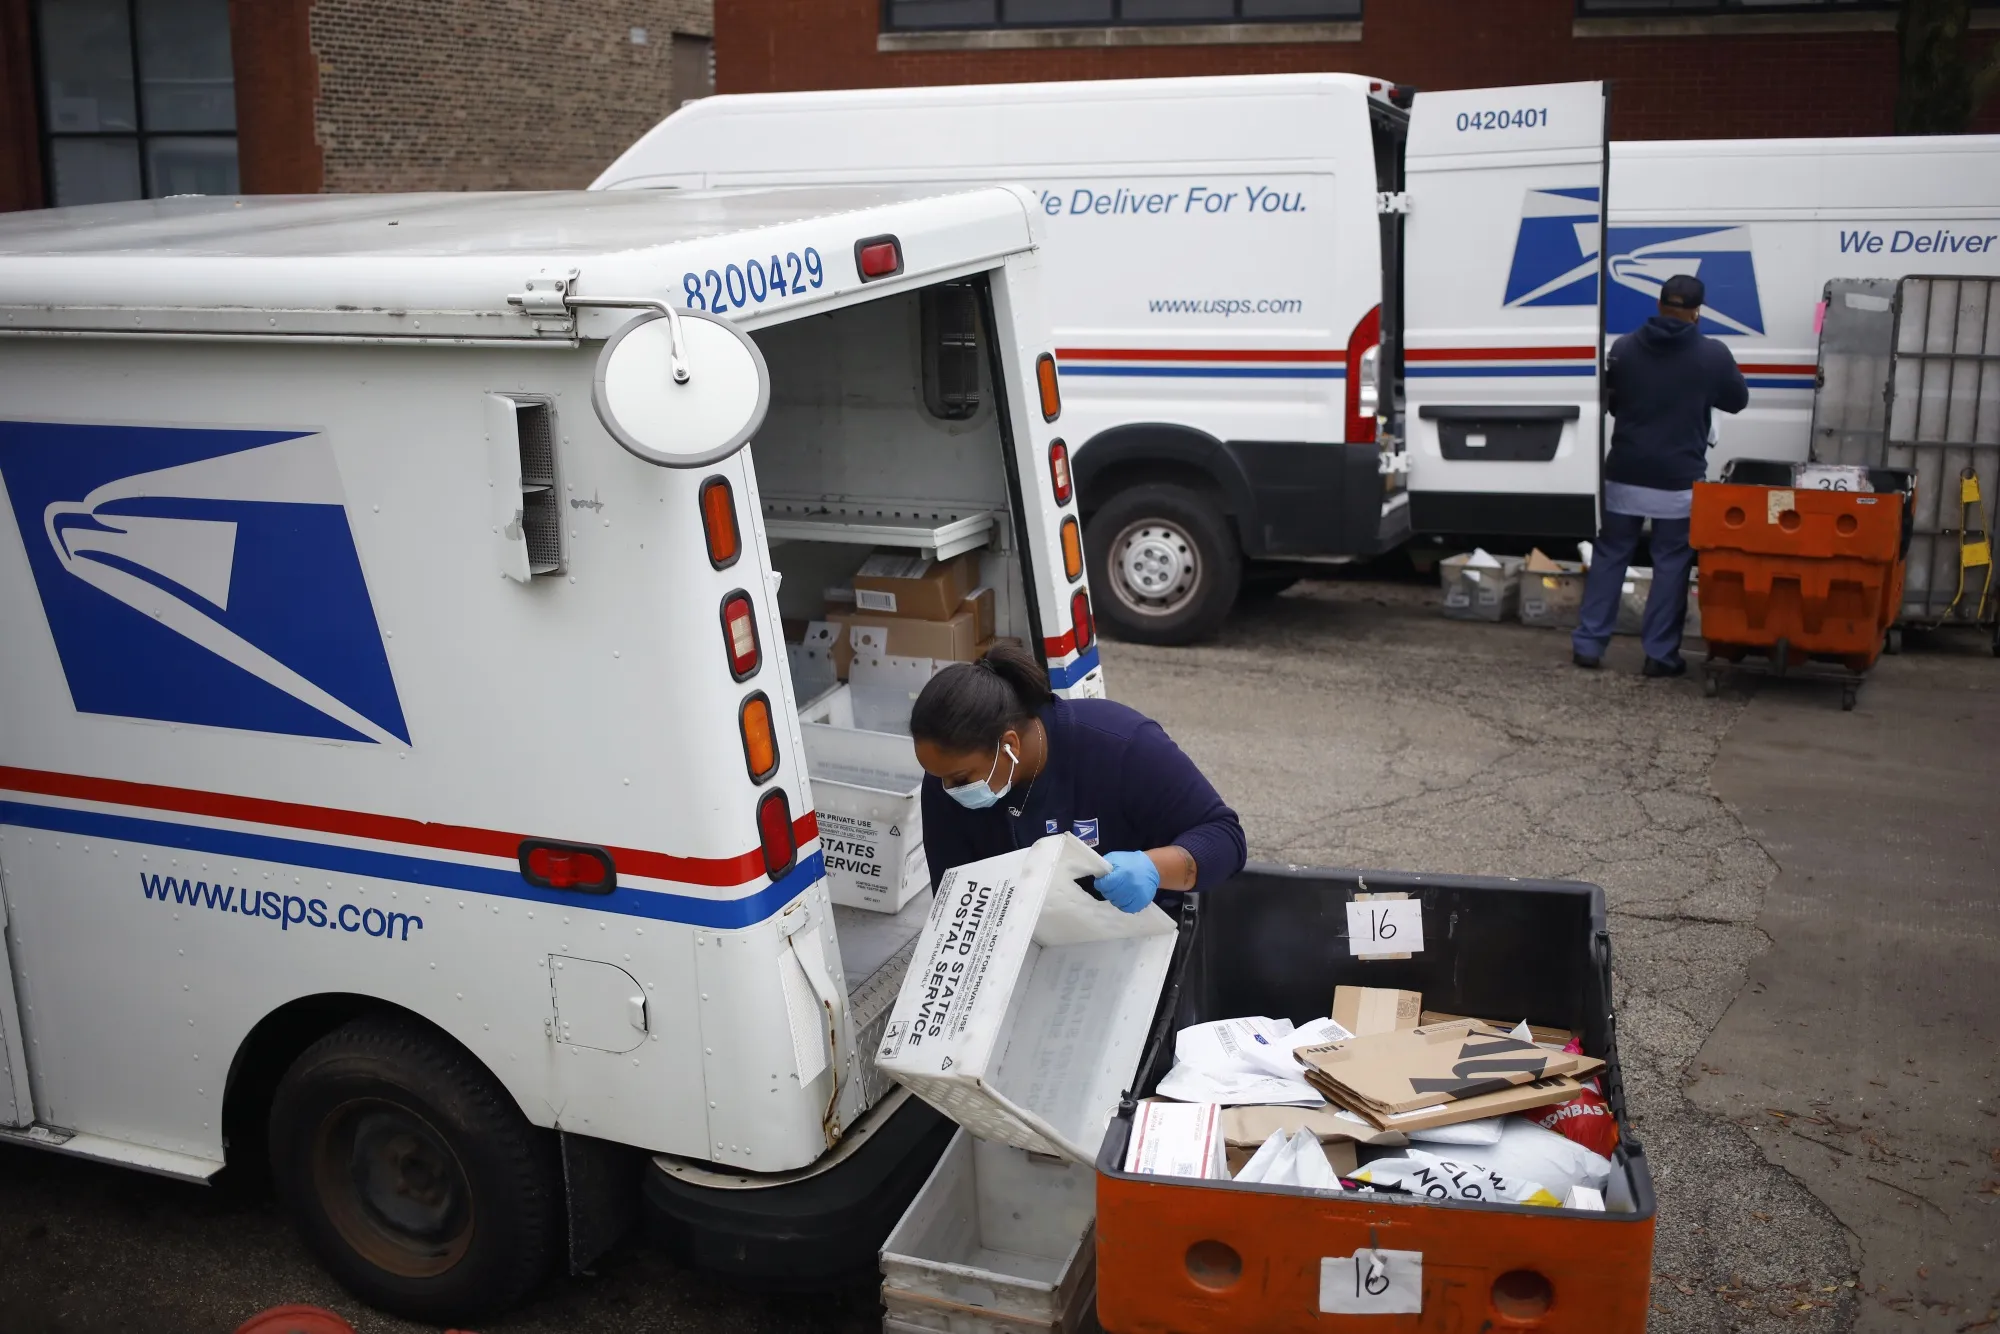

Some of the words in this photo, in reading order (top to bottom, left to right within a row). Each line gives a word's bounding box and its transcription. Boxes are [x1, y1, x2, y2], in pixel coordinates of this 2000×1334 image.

[1456, 108, 1547, 131] 0420401
[1040, 189, 1062, 215] e
[1069, 188, 1179, 215] Deliver
[1184, 187, 1238, 213] For
[1245, 186, 1306, 213] You.
[1840, 230, 1883, 253] We
[1890, 230, 1998, 253] Deliver
[683, 247, 823, 314] 8200429
[1149, 298, 1302, 317] www.usps.com
[1818, 478, 1848, 492] 36
[827, 814, 855, 825] PRIVATE
[857, 820, 871, 828] USE
[823, 855, 881, 877] ERVICE
[941, 881, 978, 954] POSTAL
[996, 886, 1015, 927] WARNING
[959, 887, 992, 956] UNITED
[1371, 908, 1397, 942] 16
[934, 933, 944, 949] FOR
[988, 934, 998, 952] NOT
[928, 950, 938, 966] MAIL
[979, 955, 990, 973] FOR
[920, 968, 931, 988] ONLY
[908, 961, 948, 1046] SERVICE
[928, 961, 964, 1037] STATES
[965, 975, 983, 1011] PRIVATE
[958, 1014, 969, 1032] USE
[1539, 1104, 1604, 1129] BOMBAS
[1355, 1256, 1390, 1298] 16
